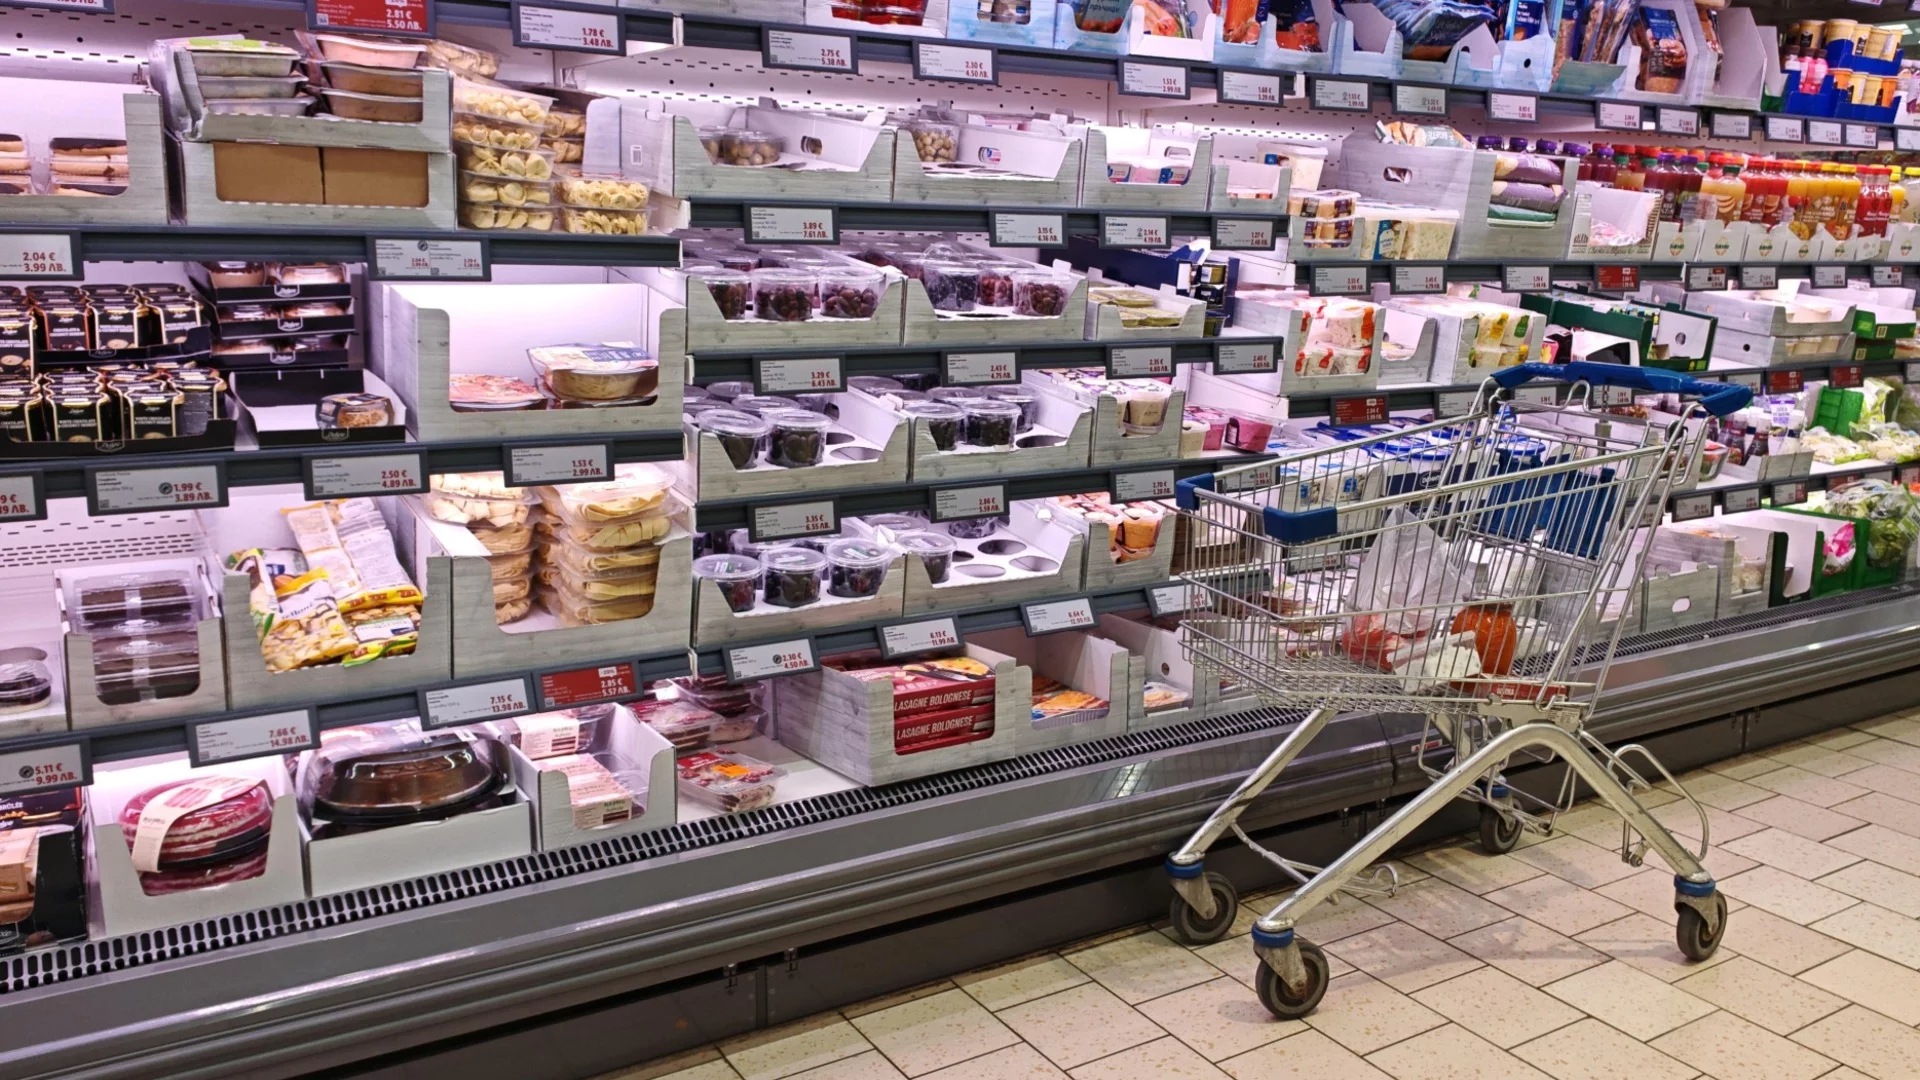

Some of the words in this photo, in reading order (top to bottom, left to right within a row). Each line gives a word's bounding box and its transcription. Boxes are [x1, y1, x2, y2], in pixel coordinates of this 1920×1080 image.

[386, 8, 403, 19] 2.81
[406, 10, 412, 20] €
[387, 20, 405, 30] 5.50
[582, 28, 597, 36] 1.78
[599, 29, 604, 37] €
[583, 37, 599, 46] 3.48
[821, 49, 834, 57] 2.75
[821, 57, 835, 65] 5.38
[965, 61, 978, 69] 2.30
[966, 69, 978, 77] 4.50
[803, 230, 816, 238] 7.61
[22, 251, 46, 261] 2.04
[48, 251, 56, 261] €
[24, 262, 46, 272] 3.99
[811, 371, 824, 379] 3.29
[572, 459, 587, 468] 1.53
[588, 459, 594, 467] €
[381, 470, 399, 479] 2.50
[401, 469, 407, 478] €
[572, 468, 588, 476] 2.99
[174, 482, 193, 492] 1.99
[195, 482, 202, 491] €
[381, 479, 400, 488] 4.89
[9, 494, 17, 503] €
[175, 493, 195, 502] 3.89
[805, 515, 818, 523] 3.35
[819, 514, 824, 522] €
[805, 522, 819, 530] 6.55
[930, 631, 941, 639] 6.13
[931, 638, 945, 646] 11.99
[782, 653, 796, 662] 2.30
[797, 652, 802, 660] €
[784, 661, 798, 669] 4.50
[600, 679, 616, 688] 2.85
[617, 678, 623, 686] €
[602, 688, 617, 697] 5.57
[490, 695, 506, 704] 7.15
[507, 694, 512, 702] €
[894, 696, 928, 712] LASAGNE
[929, 689, 973, 706] BOLOGNESE
[492, 703, 512, 712] 13.98
[896, 723, 930, 740] LASAGNE
[931, 715, 974, 732] BOLOGNESE
[269, 728, 288, 738] 7.66
[290, 727, 296, 735] €
[270, 737, 294, 748] 14.98
[35, 764, 54, 775] 5.11
[56, 763, 63, 772] €
[36, 774, 58, 785] 9.99
